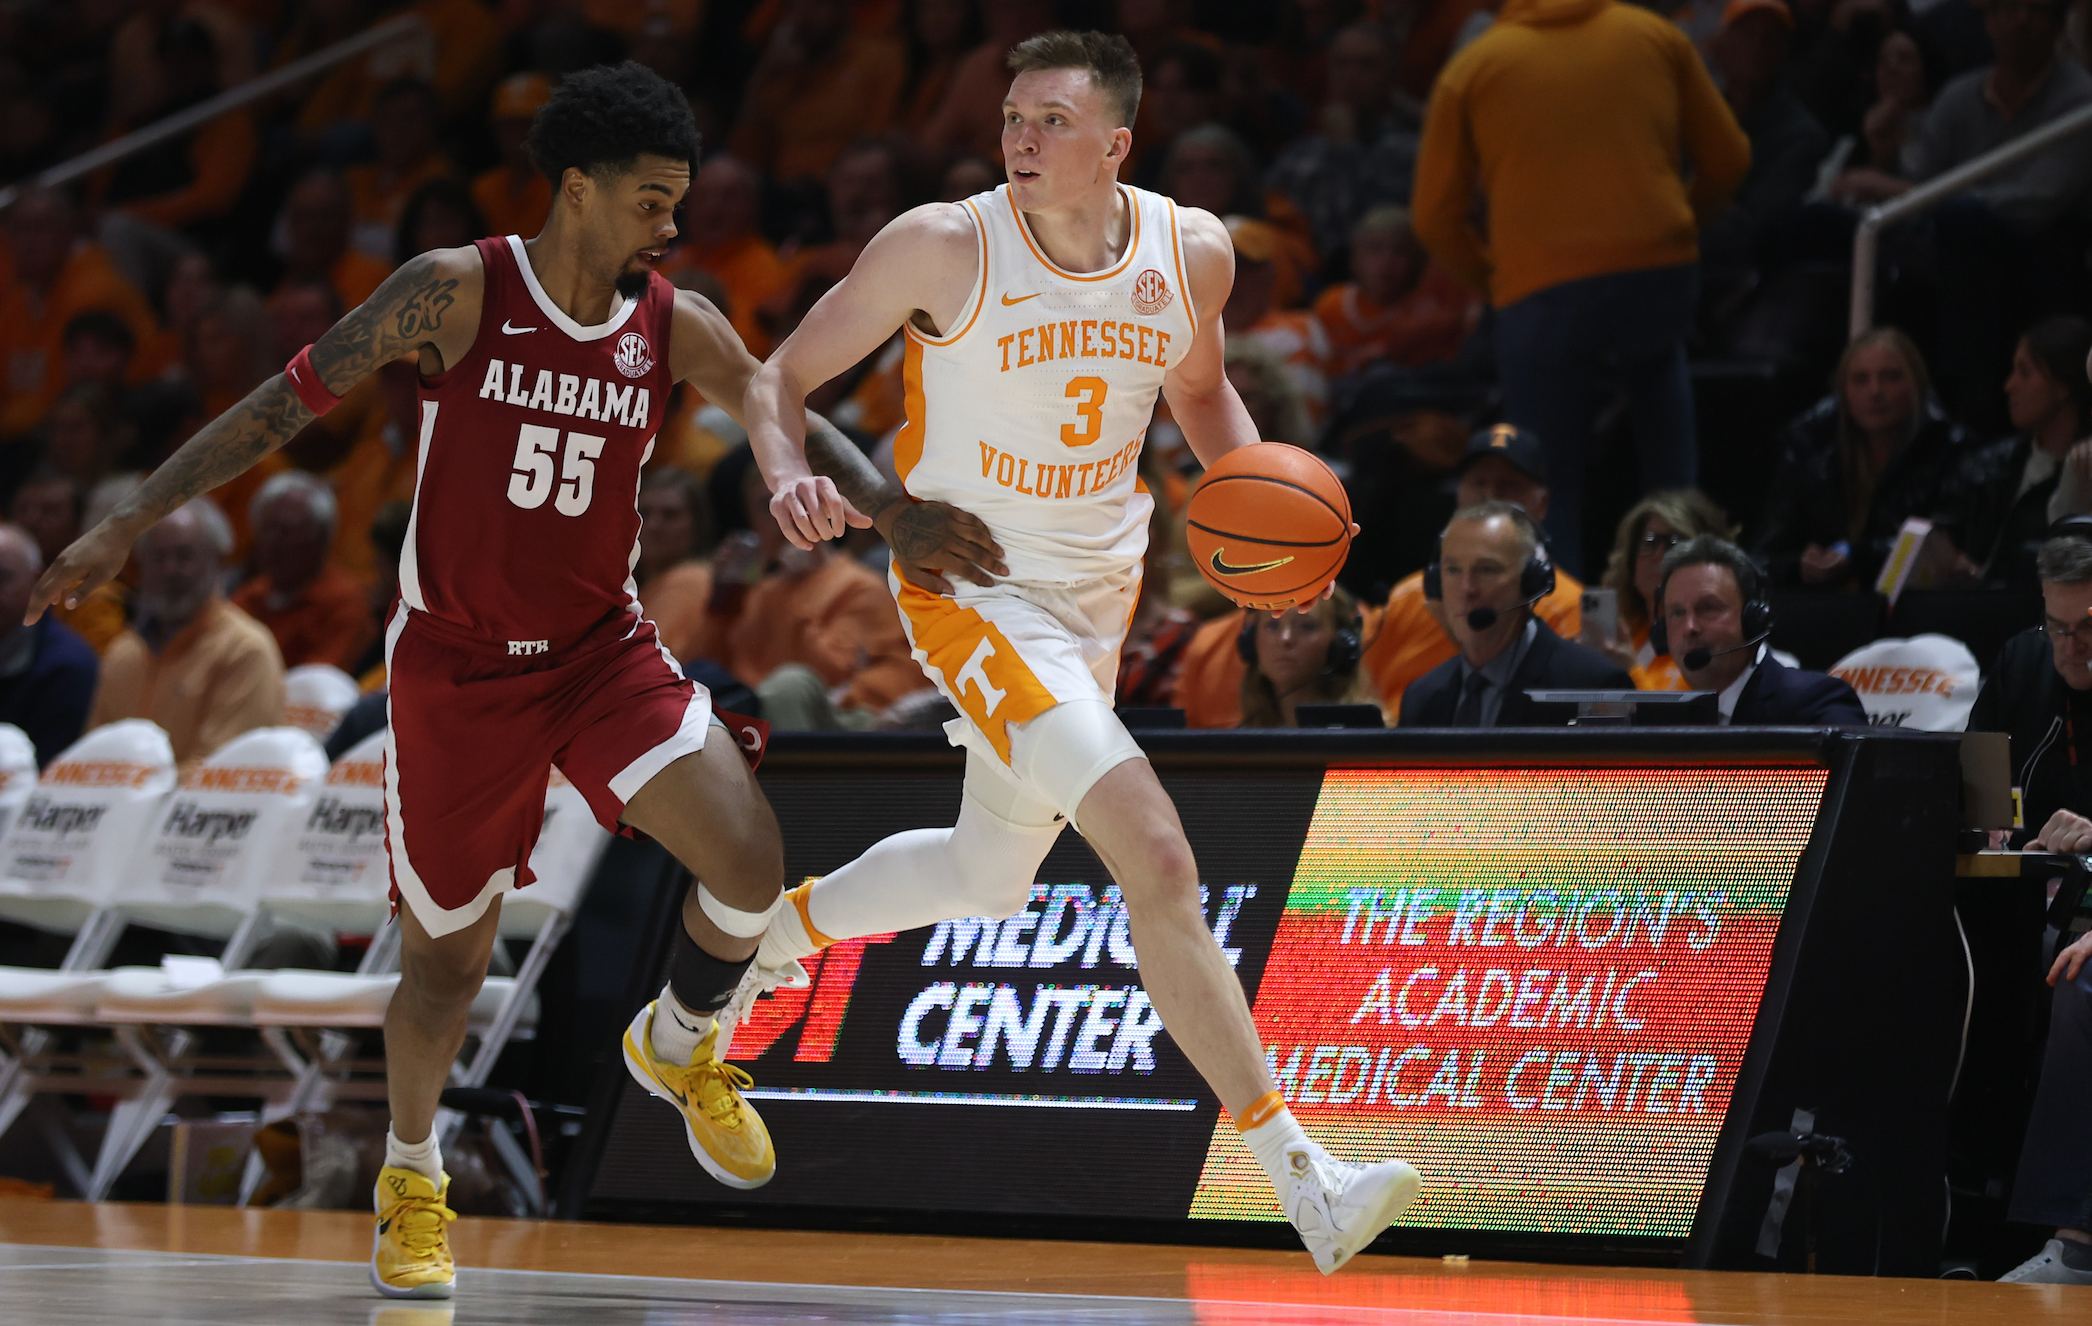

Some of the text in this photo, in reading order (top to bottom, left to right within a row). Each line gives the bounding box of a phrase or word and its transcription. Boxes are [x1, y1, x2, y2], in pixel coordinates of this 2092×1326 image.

[1137, 271, 1164, 303] SEC
[620, 335, 646, 367] SEC
[998, 320, 1171, 372] TENNESSEE
[479, 358, 651, 430] ALABAMA
[1060, 376, 1108, 448] 3
[507, 423, 606, 517] 55
[507, 639, 549, 656] RTR
[1338, 886, 1727, 954] THE REGION'S
[896, 981, 1164, 1075] CENTER
[1349, 964, 1659, 1031] ACADEMIC
[1505, 1049, 1718, 1114] CENTER
